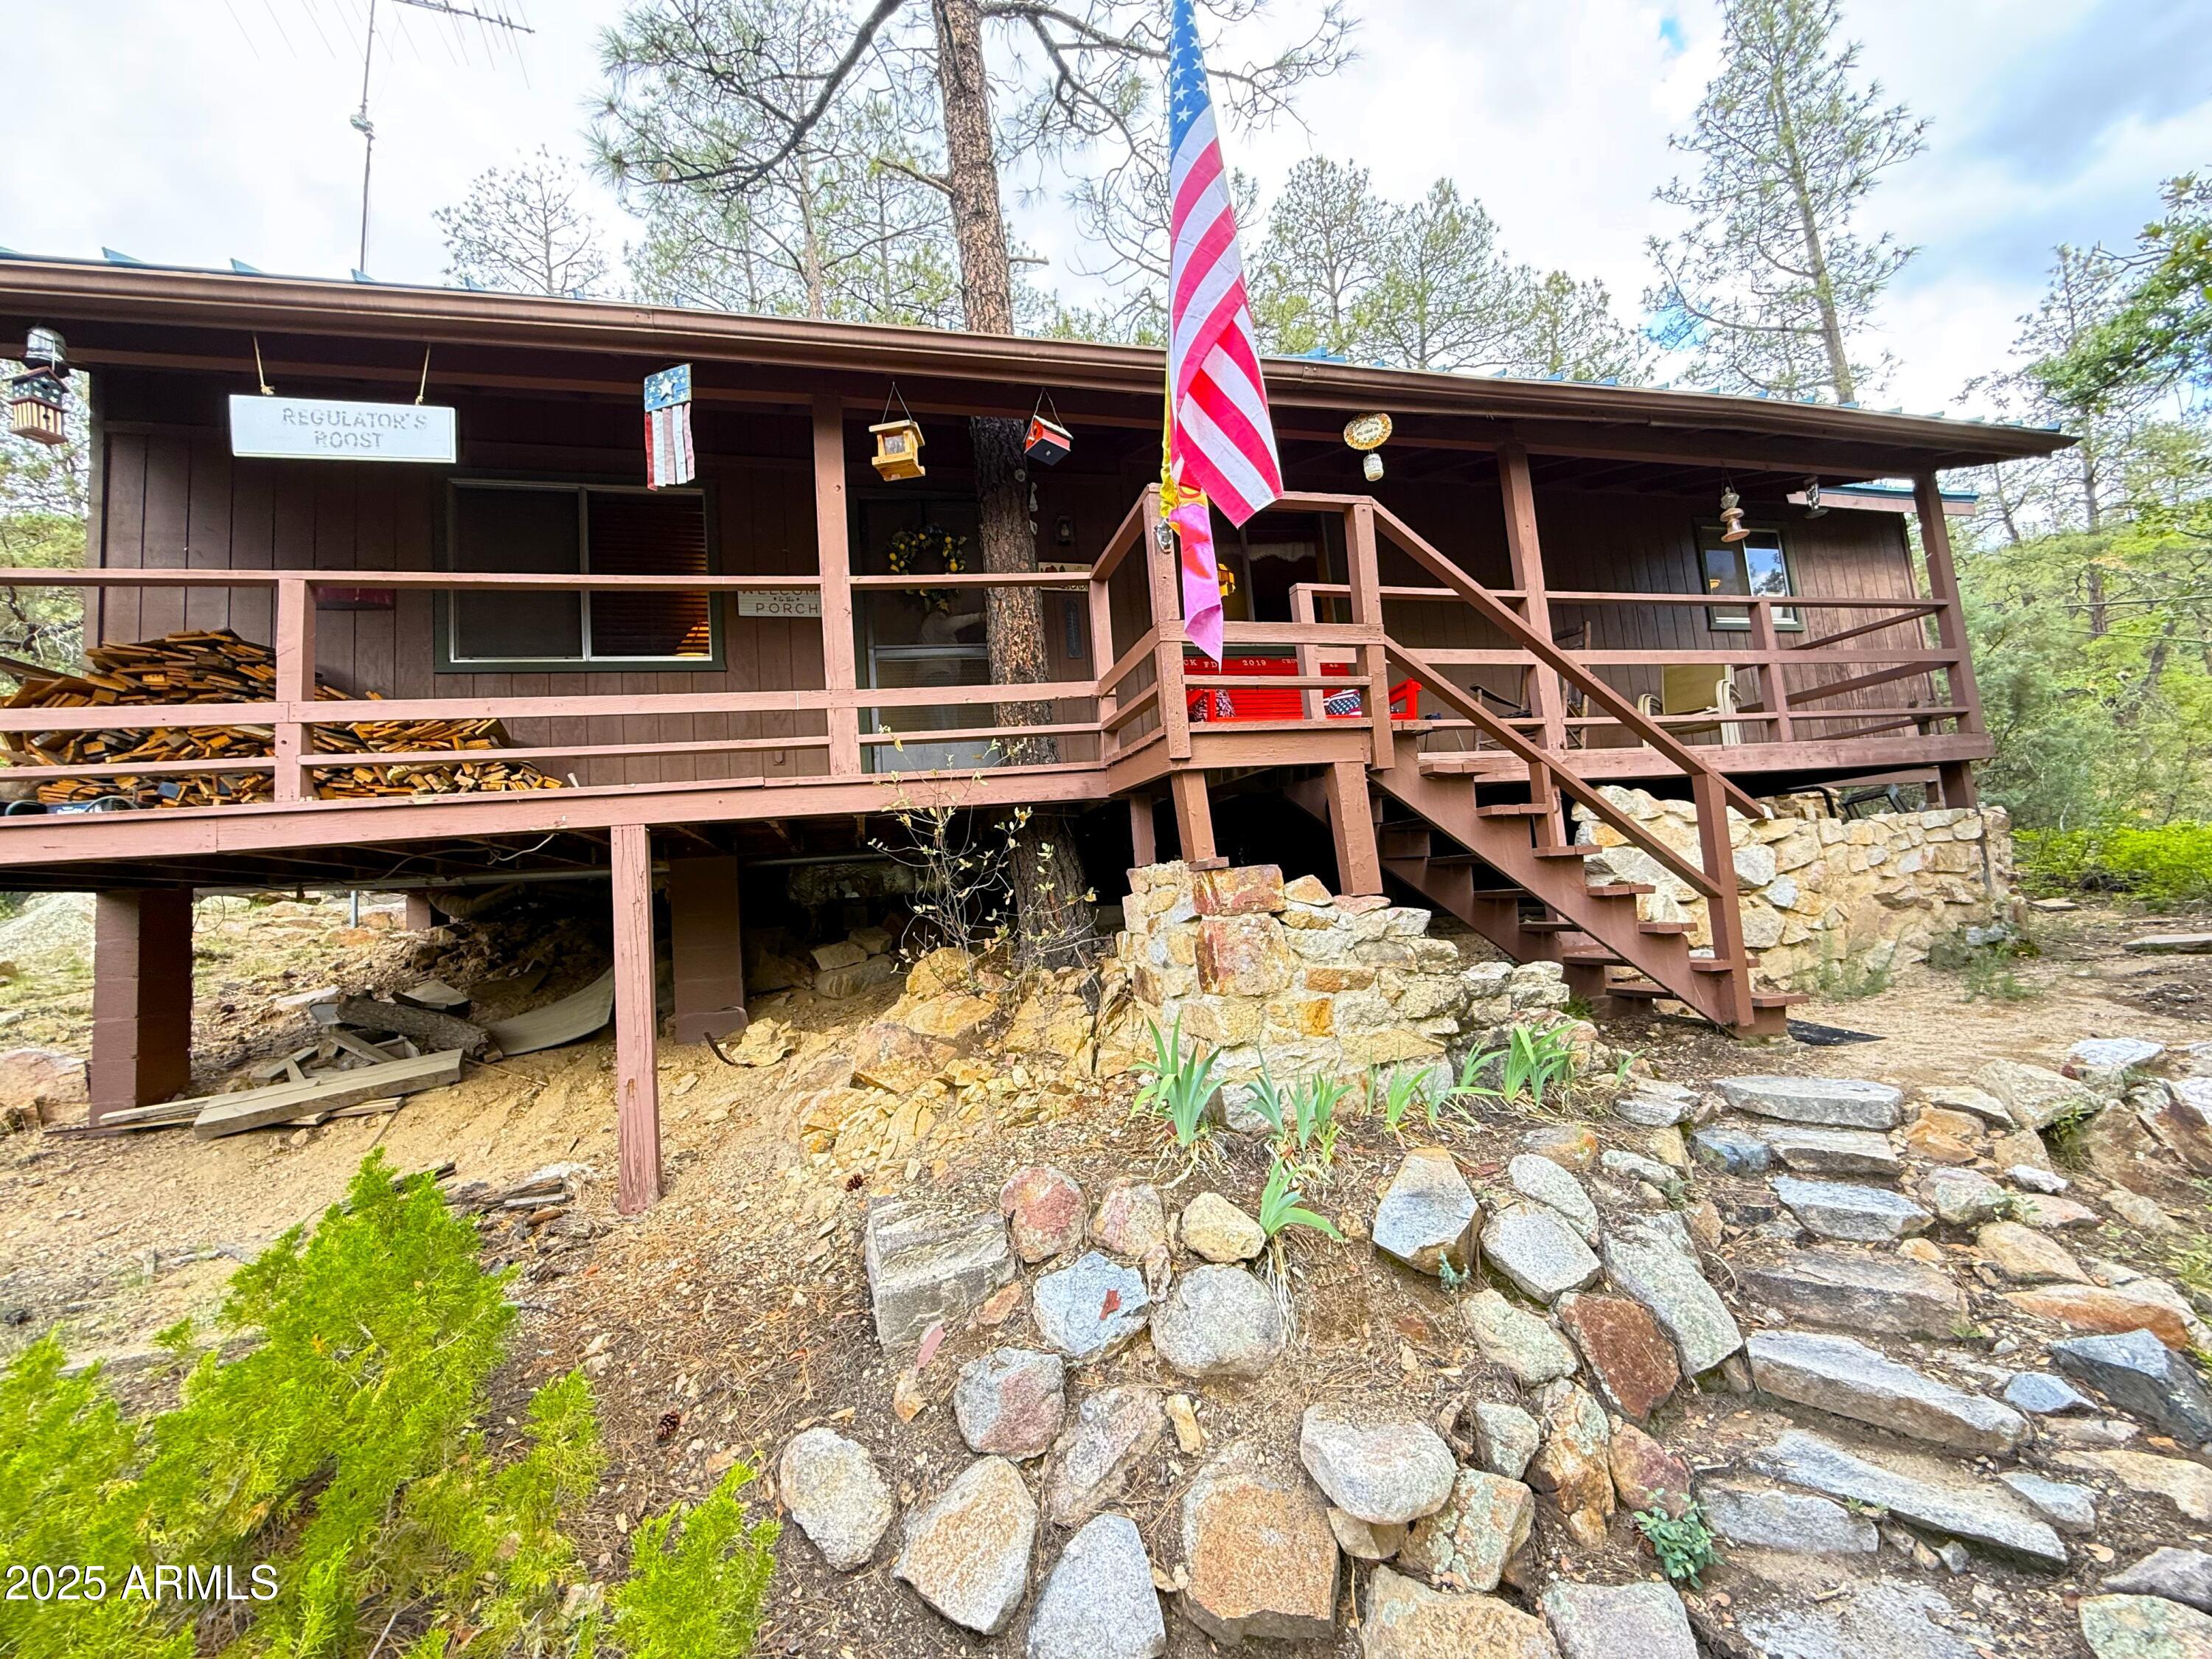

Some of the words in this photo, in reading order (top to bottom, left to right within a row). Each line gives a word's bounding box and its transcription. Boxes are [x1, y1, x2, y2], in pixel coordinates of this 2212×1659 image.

[282, 407, 427, 430] REGULATOR'S
[314, 431, 383, 448] ROOST
[756, 603, 818, 613] PORCH
